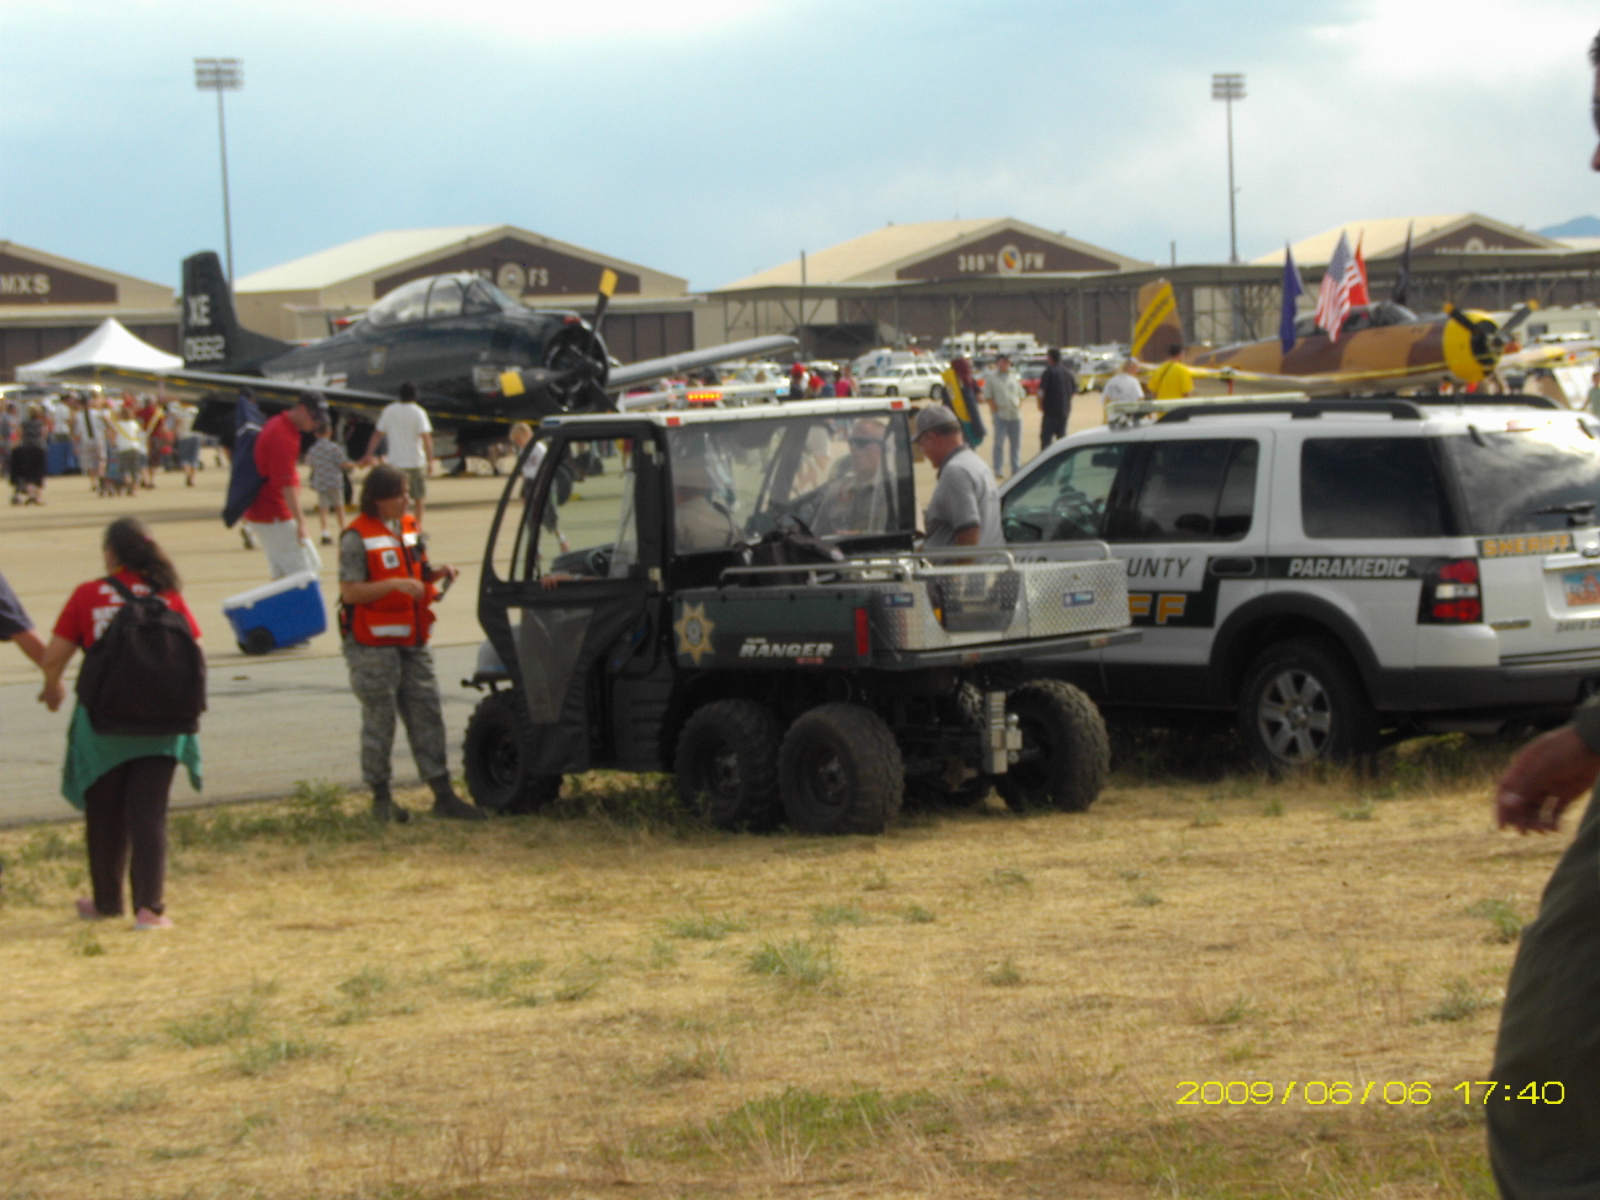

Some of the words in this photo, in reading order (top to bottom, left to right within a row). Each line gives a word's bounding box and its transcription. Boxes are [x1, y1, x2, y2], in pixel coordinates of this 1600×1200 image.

[1483, 533, 1570, 557] SHERIFF
[1126, 557, 1192, 578] UNTY
[1288, 558, 1410, 578] PARAMEDIC
[739, 643, 834, 658] RANGER
